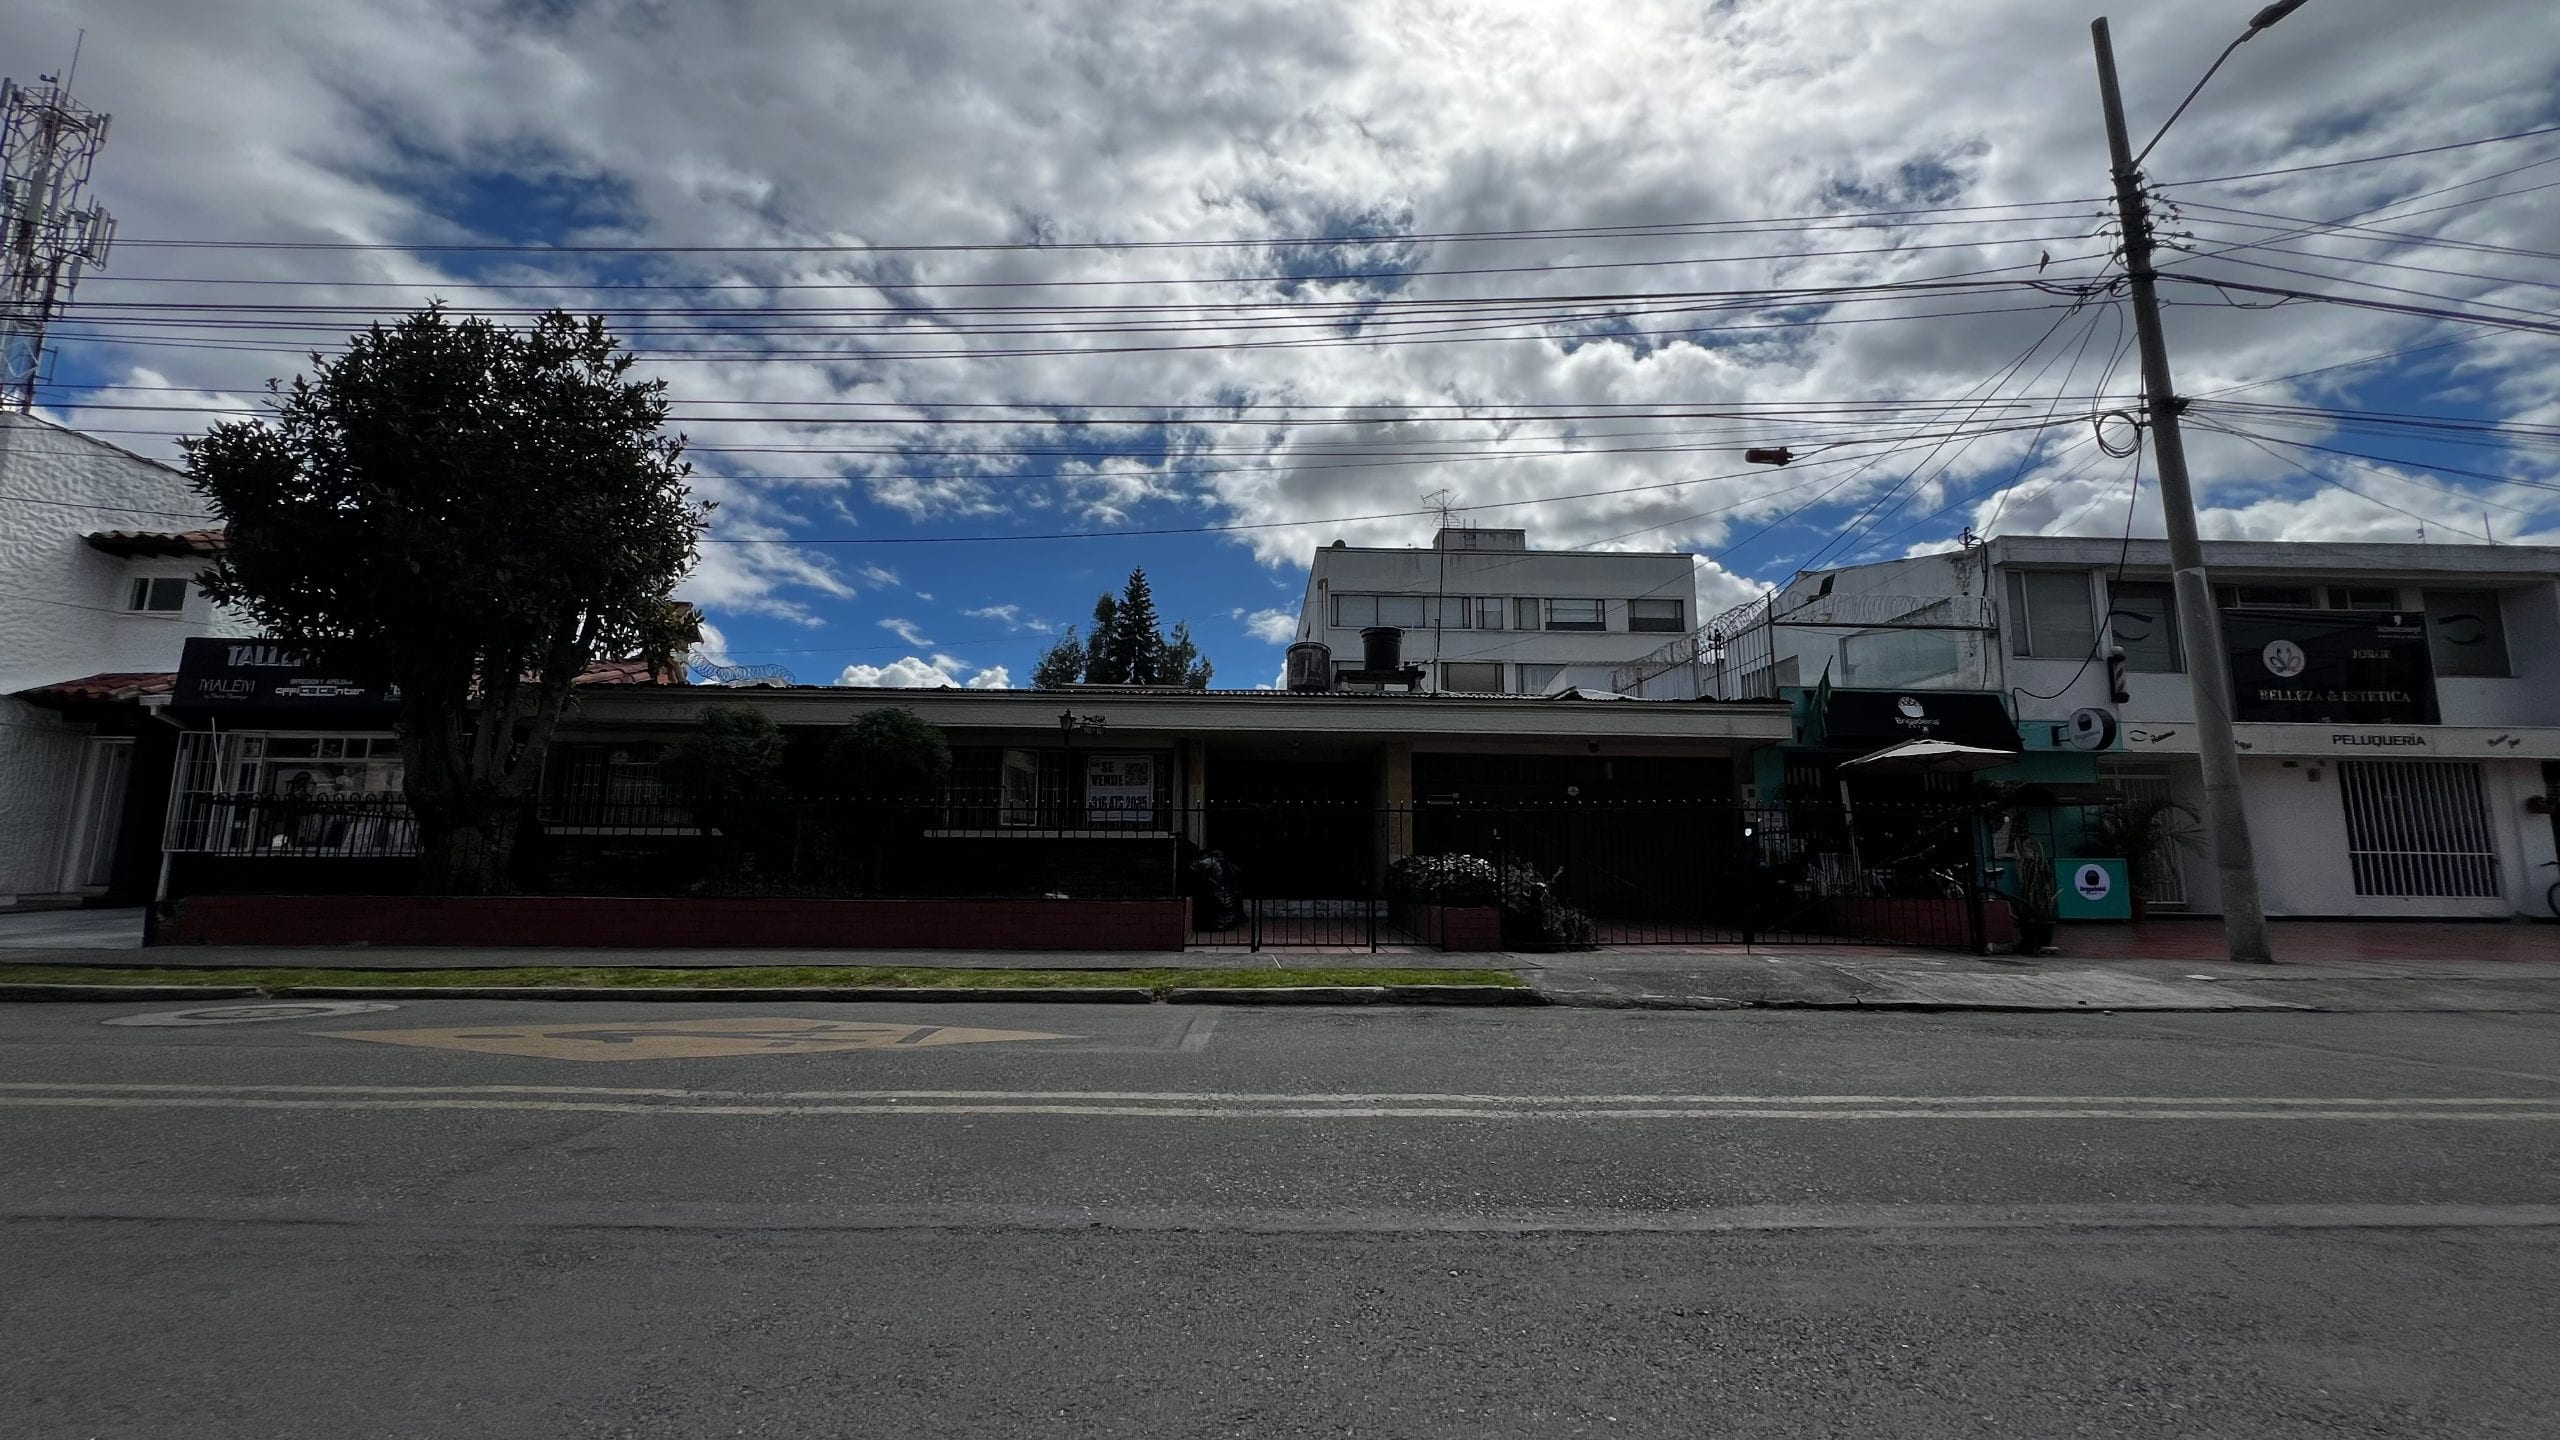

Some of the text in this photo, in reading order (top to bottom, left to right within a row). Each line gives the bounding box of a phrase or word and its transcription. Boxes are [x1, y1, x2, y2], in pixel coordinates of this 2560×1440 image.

[2259, 689, 2412, 703] BELLEZA & ESTETICA
[2333, 733, 2426, 746] PELUQUERÍA
[1101, 761, 1114, 773] SE
[1091, 774, 1124, 786] VENDE
